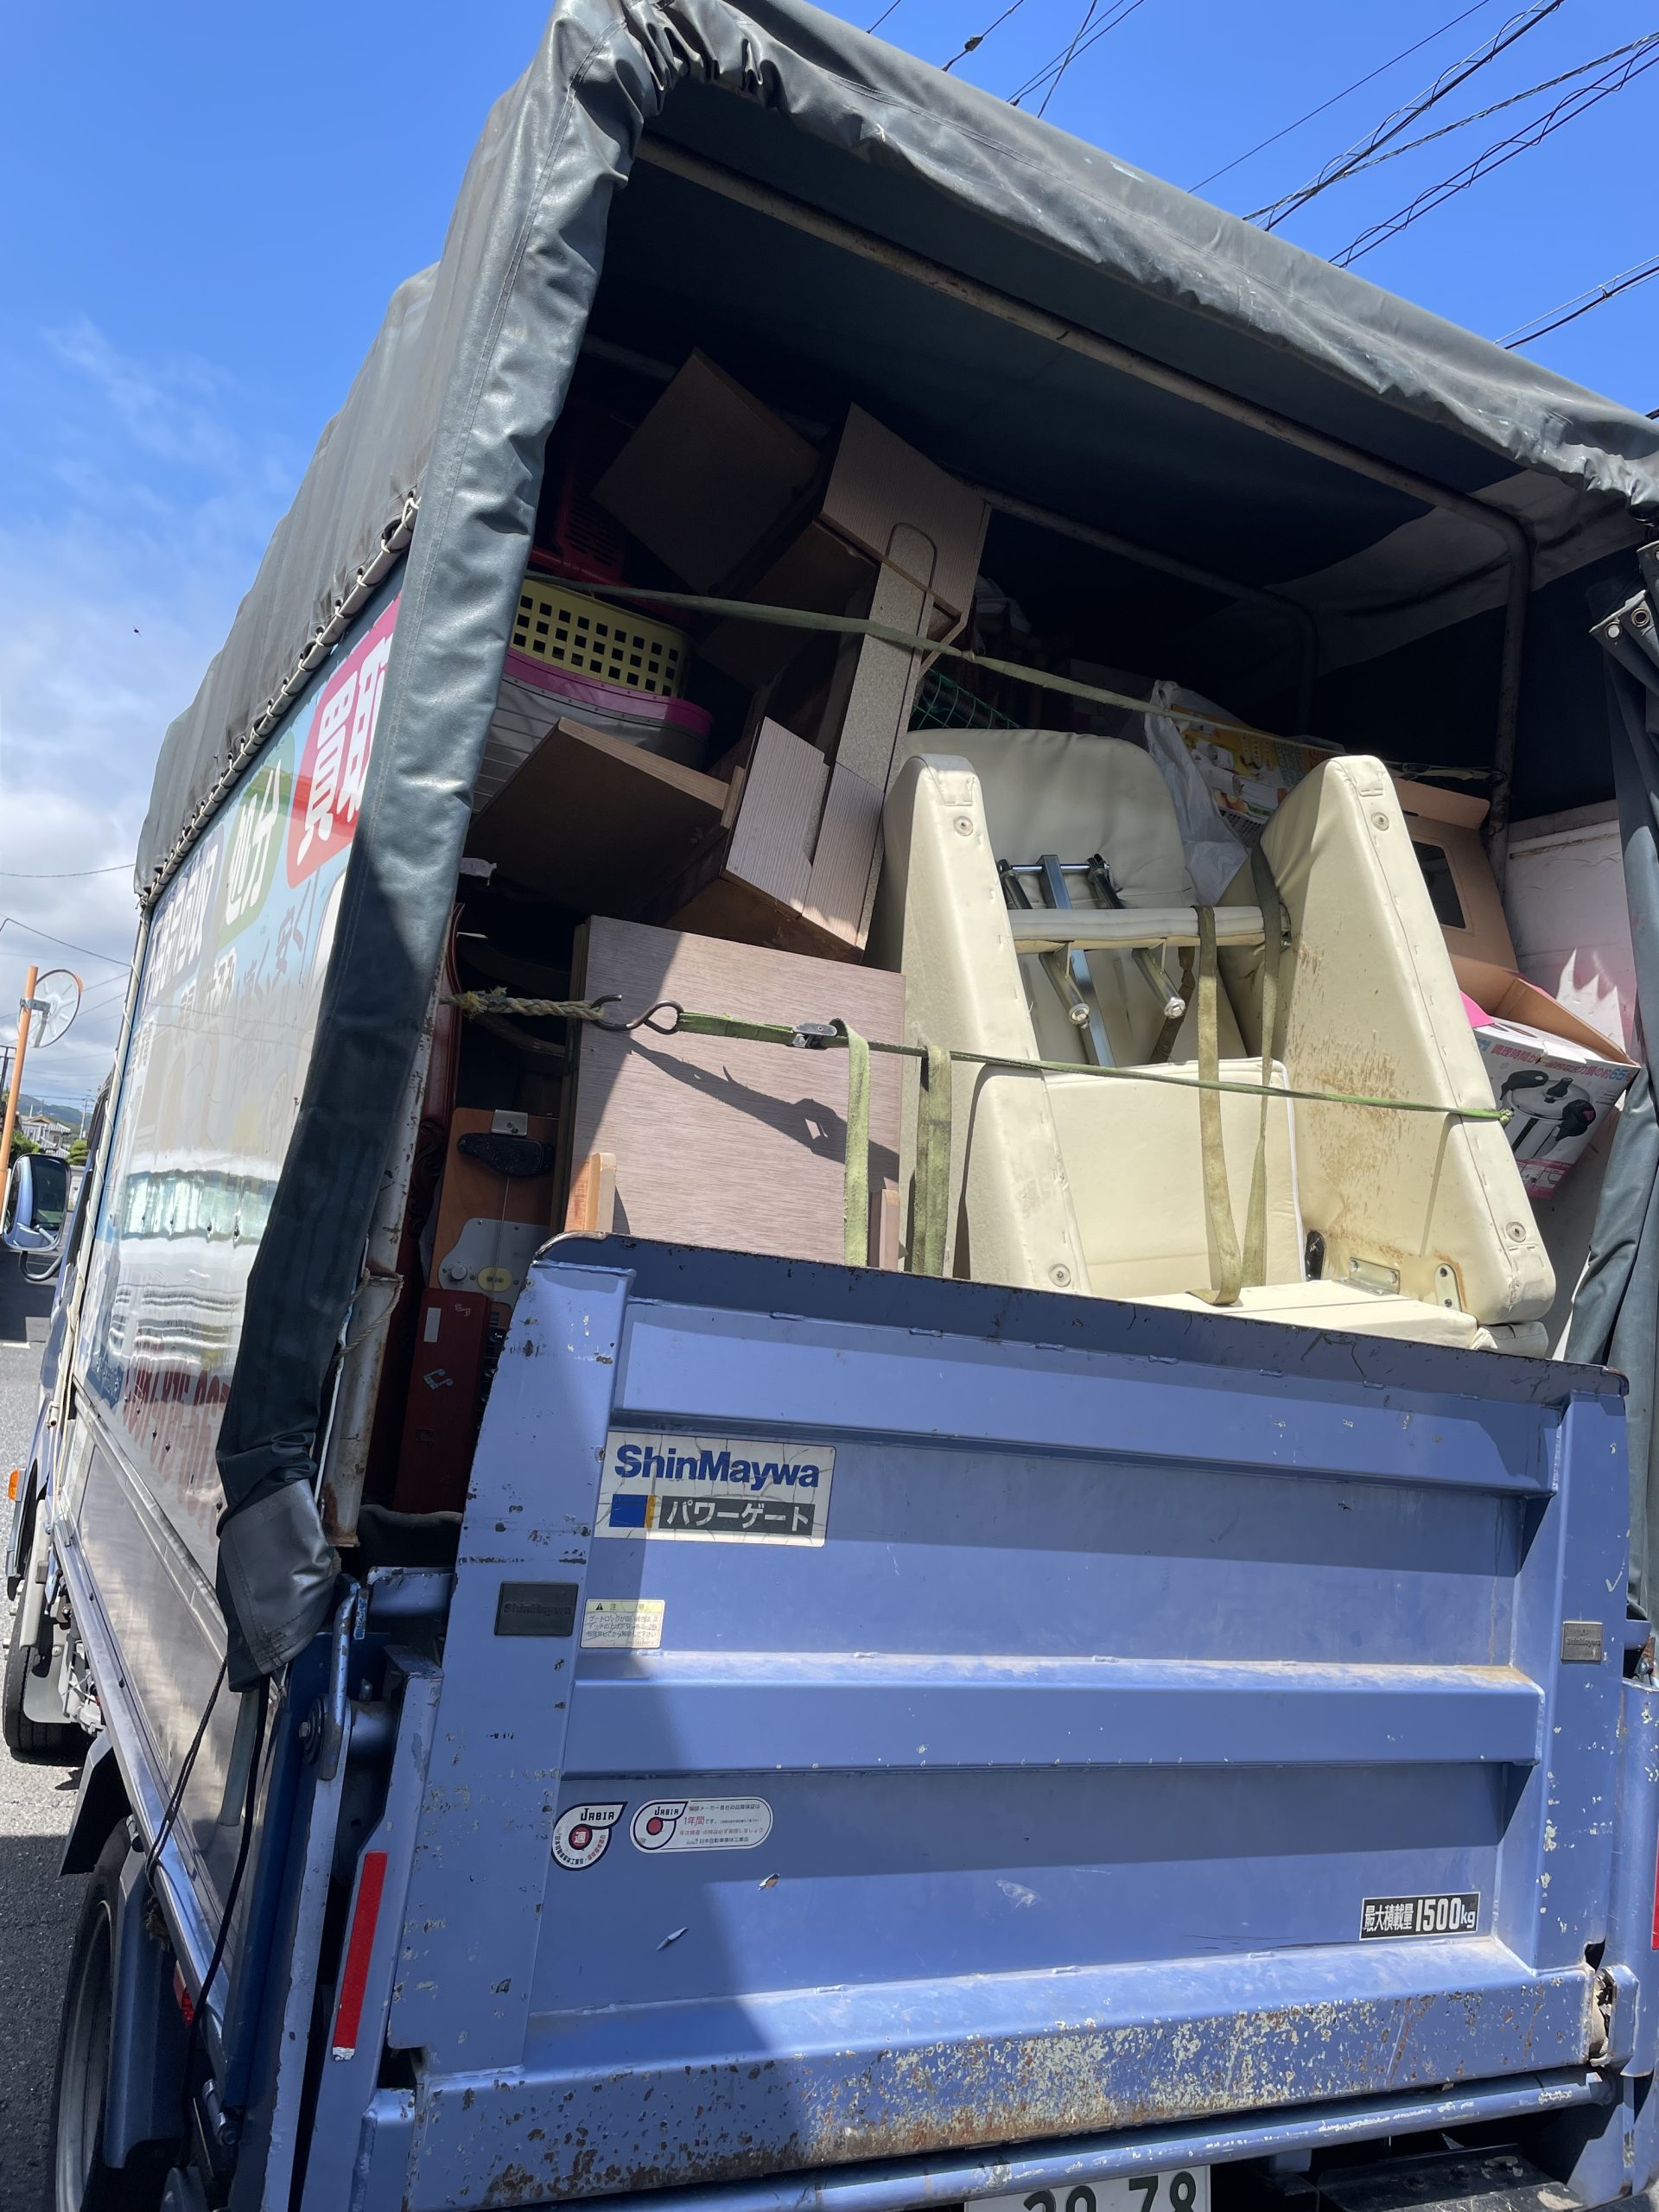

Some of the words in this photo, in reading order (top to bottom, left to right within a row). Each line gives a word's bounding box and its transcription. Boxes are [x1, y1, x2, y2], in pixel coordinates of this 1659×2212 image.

[141, 844, 219, 1018] 不用品回収
[226, 760, 281, 925] 処分
[614, 1444, 820, 1491] ShinMaywa
[666, 1497, 810, 1532] パワーゲート
[1363, 1903, 1414, 1932] 最大積載量
[1415, 1897, 1476, 1932] 1500kg
